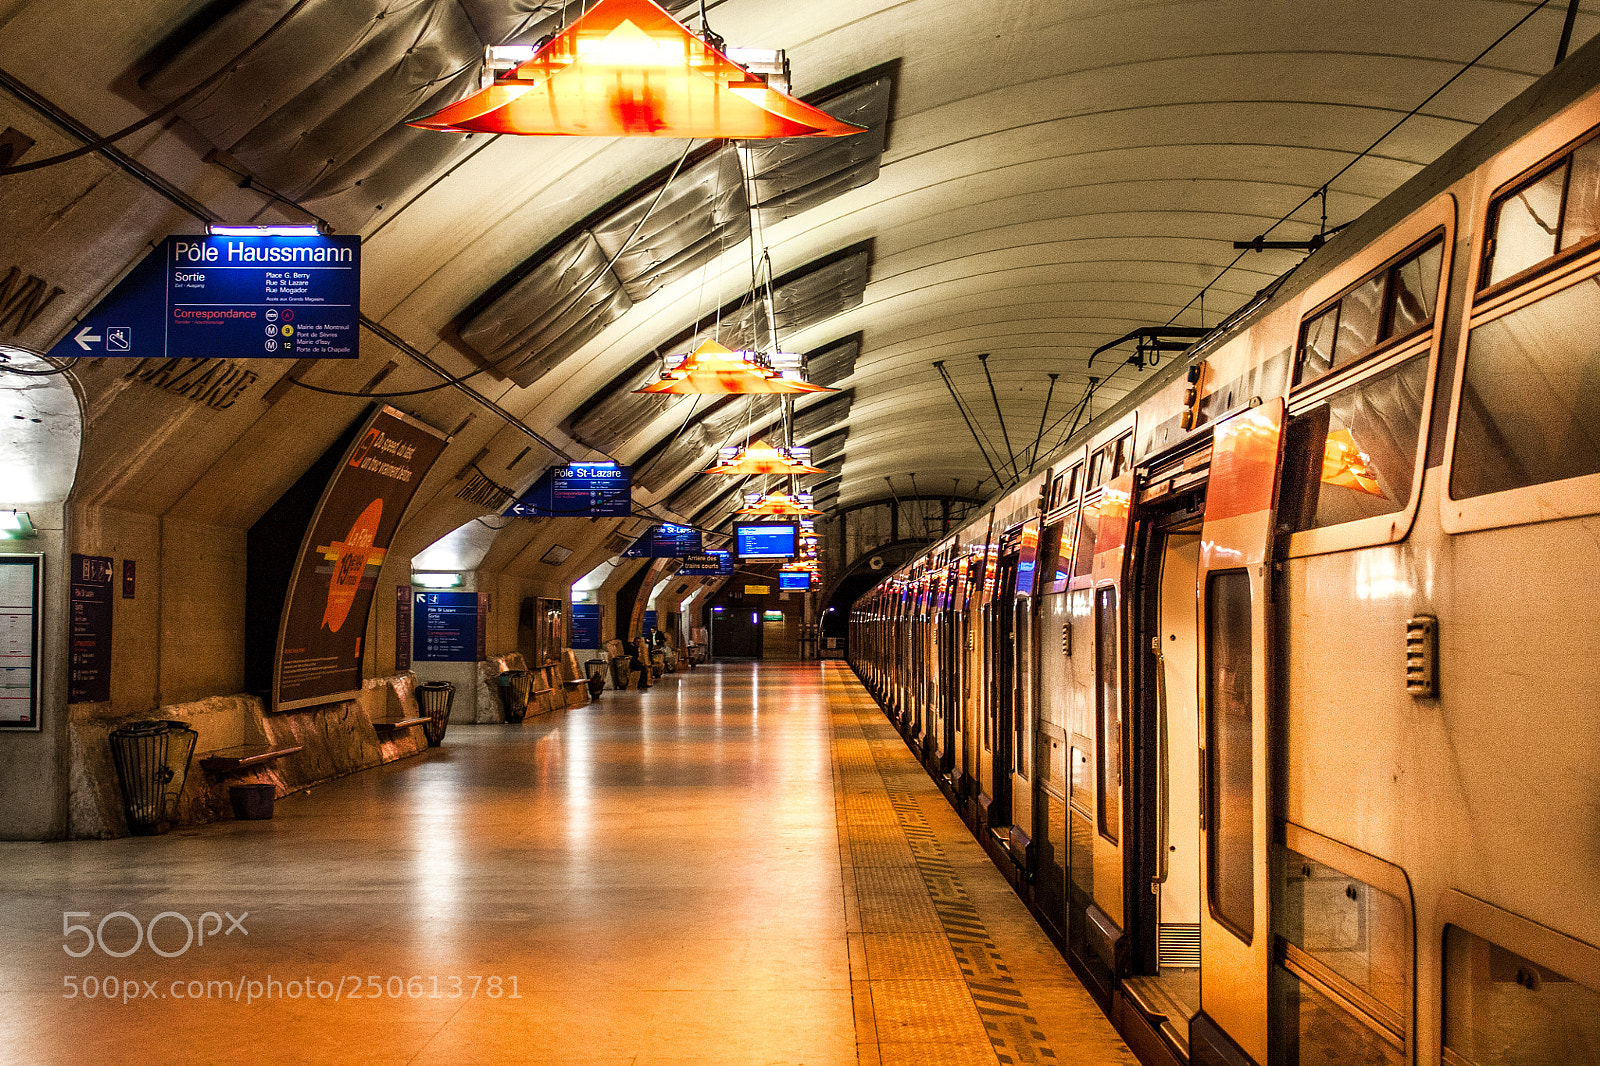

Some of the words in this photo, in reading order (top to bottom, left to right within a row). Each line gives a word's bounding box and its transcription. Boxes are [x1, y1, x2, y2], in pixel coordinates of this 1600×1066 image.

[175, 242, 218, 261] Pôle
[228, 241, 352, 262] Haussmann
[174, 272, 205, 282] Sortie
[293, 272, 310, 280] Berry
[174, 308, 257, 320] Correspondance
[554, 468, 574, 478] Pôle
[576, 468, 621, 478] St-Lazare
